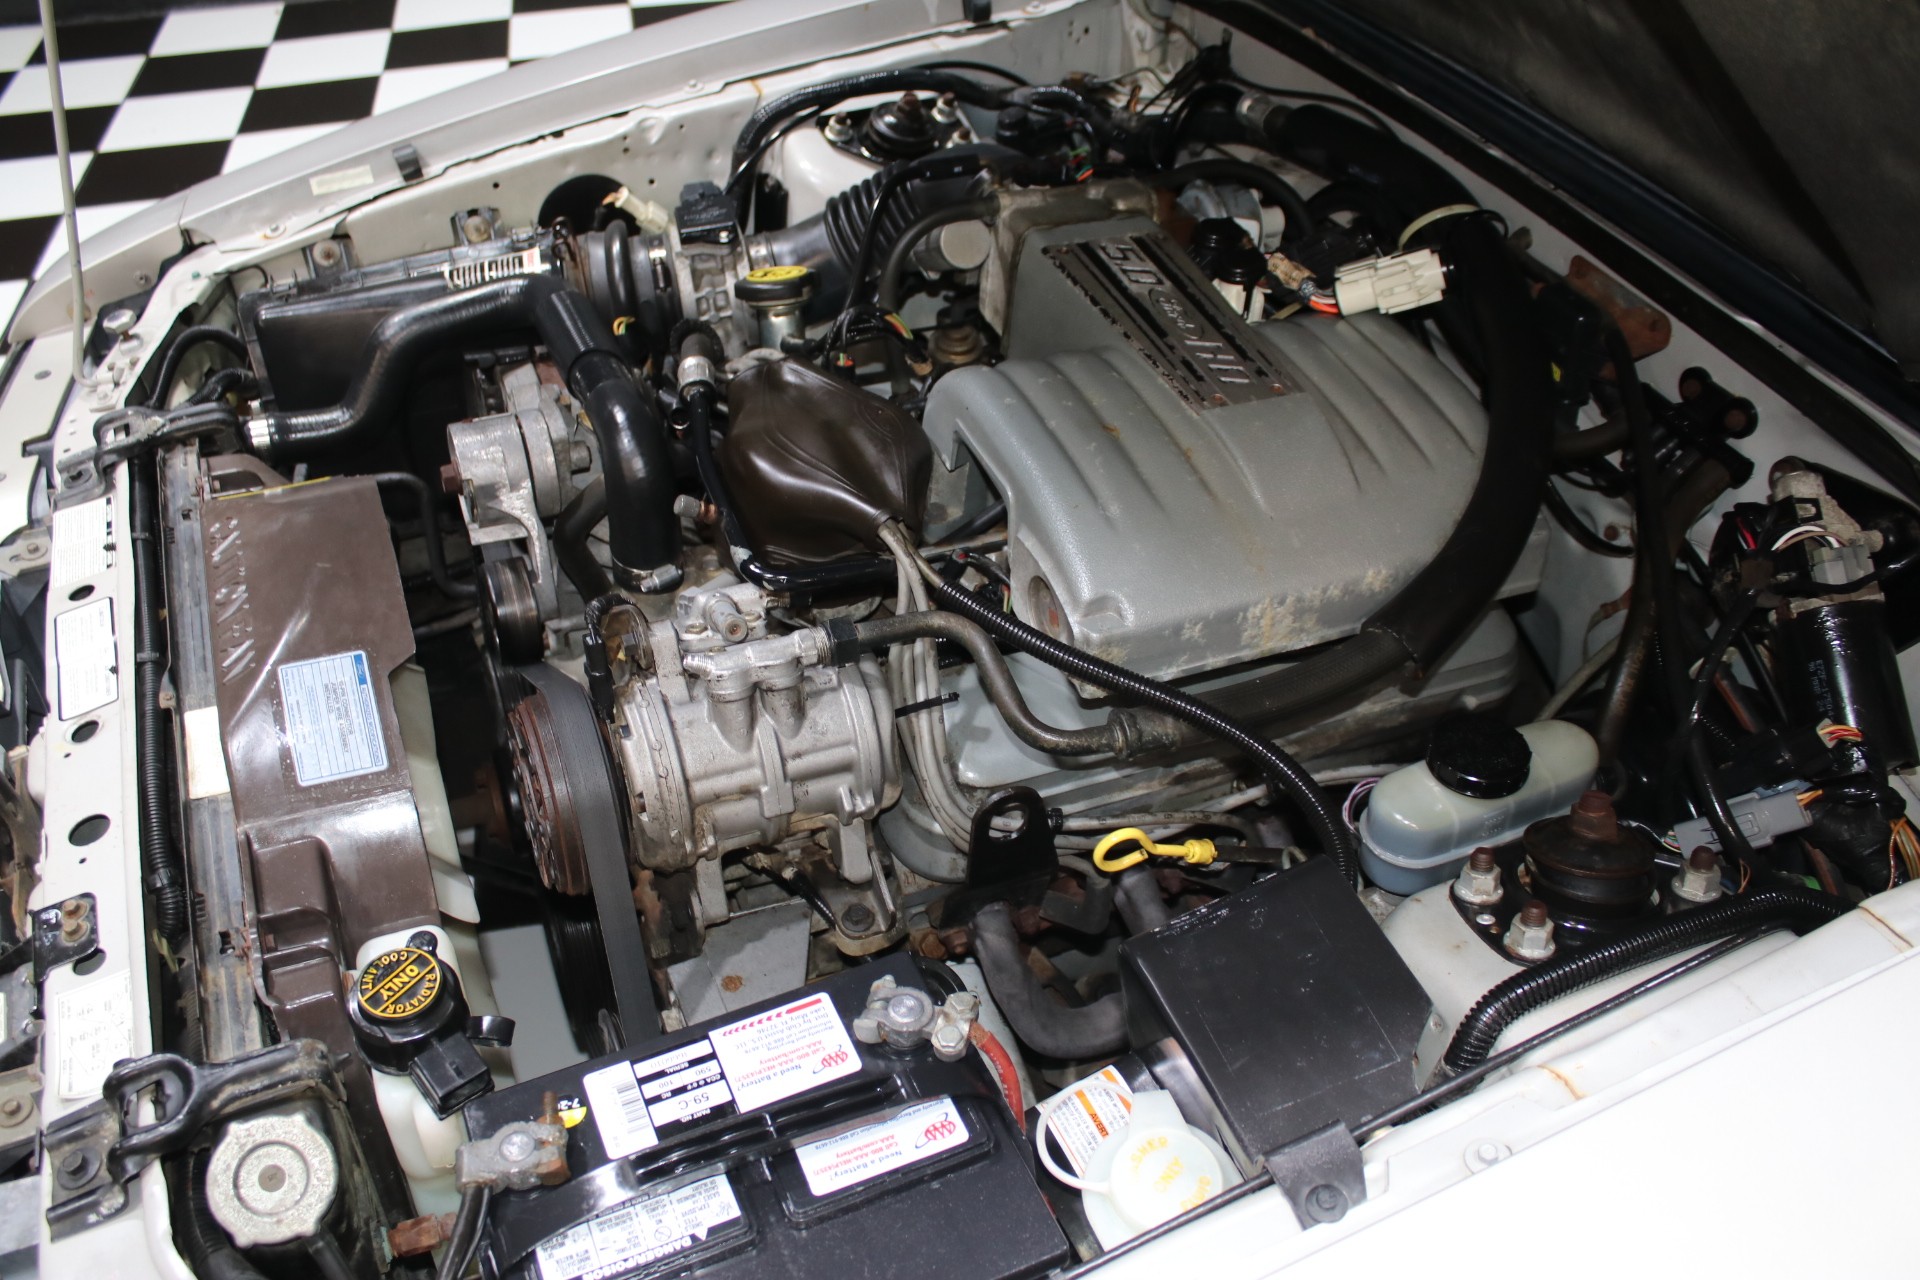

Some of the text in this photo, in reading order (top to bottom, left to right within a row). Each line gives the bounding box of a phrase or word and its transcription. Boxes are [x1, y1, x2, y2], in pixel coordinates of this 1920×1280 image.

[323, 683, 334, 714] INSTALLED
[341, 698, 353, 735] CONNECTOR
[361, 951, 408, 991] COOLANT
[379, 964, 419, 1001] ONLY
[386, 973, 436, 1014] RADIATOR
[810, 1045, 825, 1055] Call
[820, 1048, 849, 1069] AAA
[663, 1061, 688, 1074] SERIAL
[694, 1065, 711, 1076] 590
[780, 1063, 801, 1074] Need
[657, 1079, 673, 1089] 100
[705, 1073, 721, 1083] CCA
[735, 1072, 771, 1091] Battery?
[660, 1091, 671, 1099] RC
[677, 1091, 710, 1110] 59-C
[679, 1107, 711, 1123] PART NO.
[922, 1118, 957, 1143] AAA
[884, 1140, 898, 1150] Call
[878, 1149, 902, 1163] Need
[581, 1234, 692, 1280] DANGER/POISON
